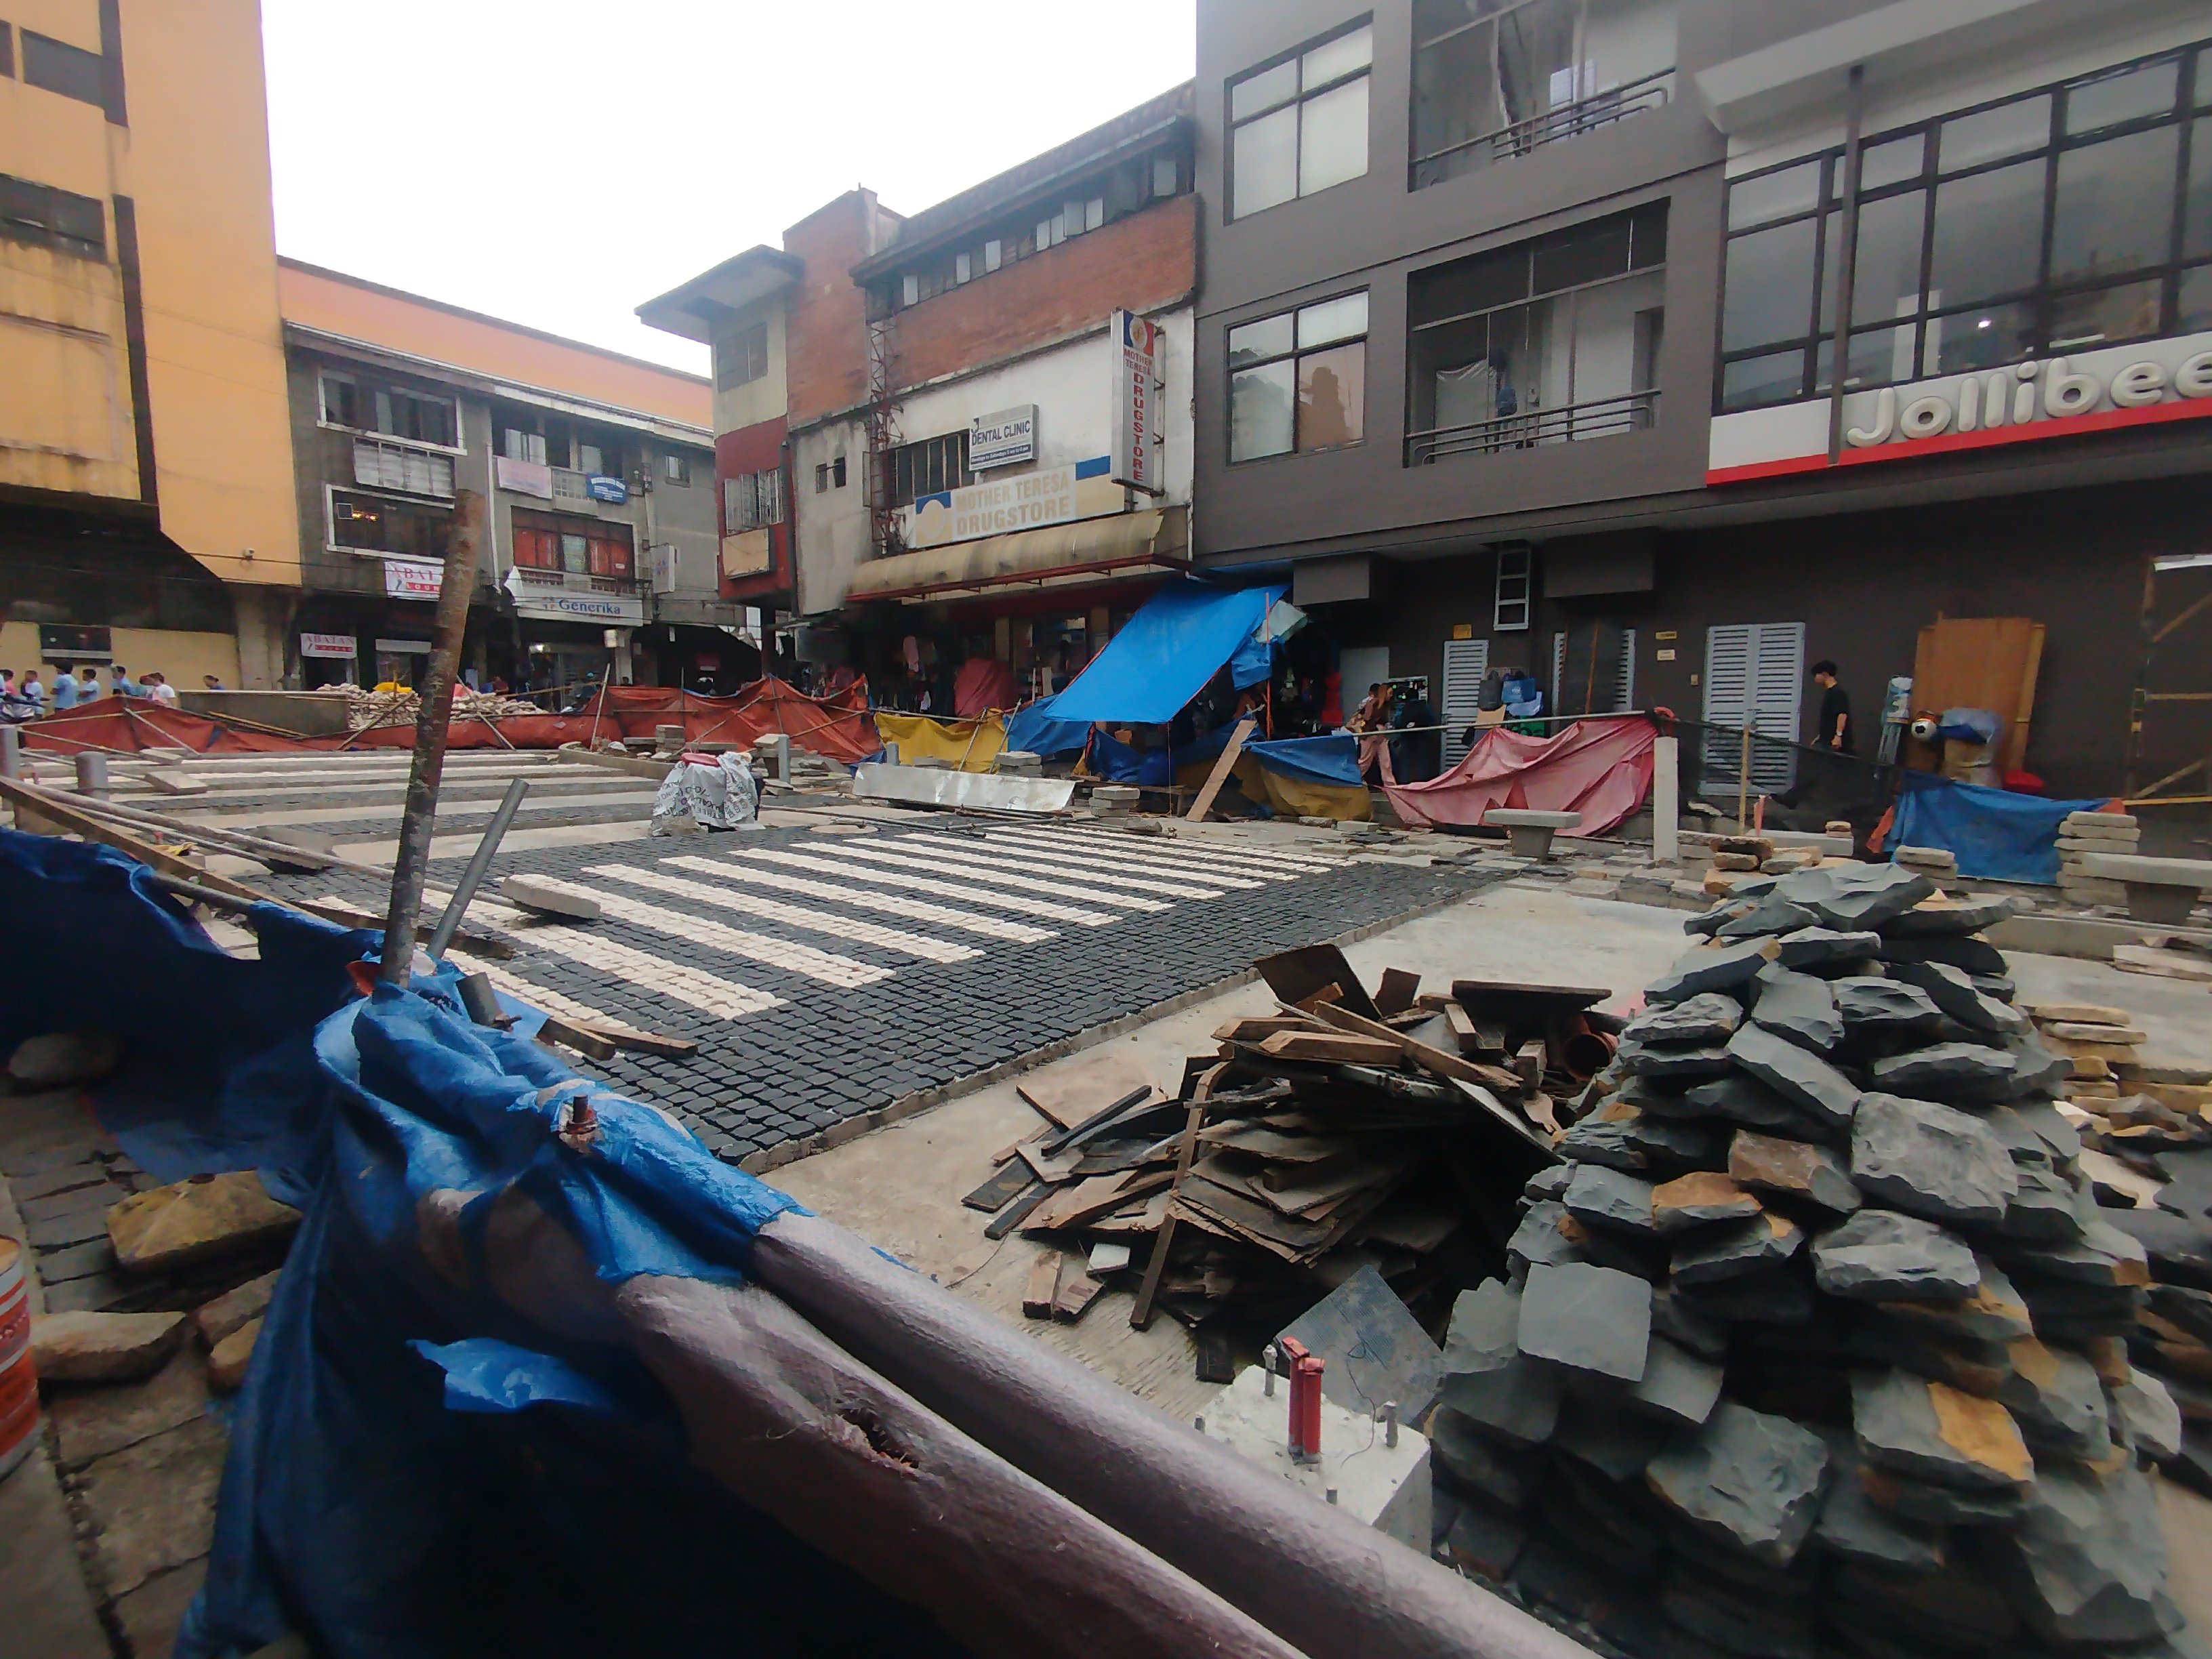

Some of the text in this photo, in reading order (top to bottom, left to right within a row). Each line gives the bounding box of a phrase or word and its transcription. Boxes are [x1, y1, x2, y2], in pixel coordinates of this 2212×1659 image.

[1124, 348, 1152, 365] MOTHER
[1126, 359, 1151, 376] TERESA
[1847, 350, 2212, 447] Jollibee
[972, 419, 1030, 446] DENTAL CLINIC
[1133, 372, 1144, 482] DRUGSTORE
[956, 472, 1069, 512] MOTHER TERESA
[957, 496, 1069, 535] DRUGSTORE
[559, 599, 620, 615] Generika
